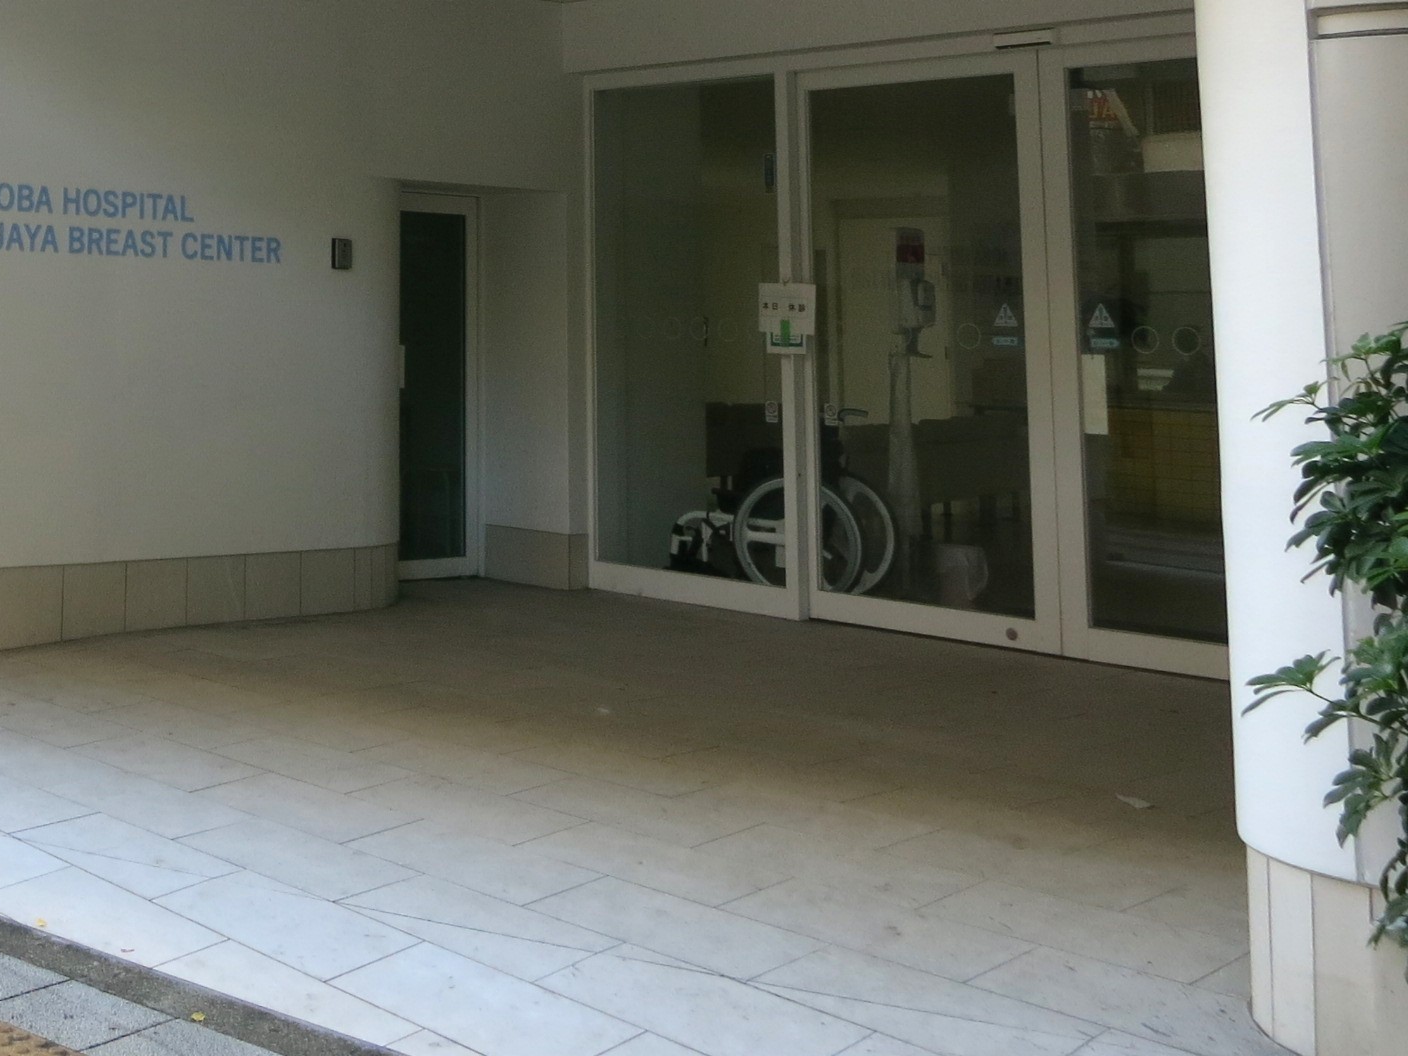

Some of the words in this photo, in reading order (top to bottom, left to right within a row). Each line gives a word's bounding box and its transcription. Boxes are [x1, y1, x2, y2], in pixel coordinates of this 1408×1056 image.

[63, 187, 195, 223] HOSPITAL
[68, 225, 173, 260] BREAST
[181, 232, 282, 264] CENTER
